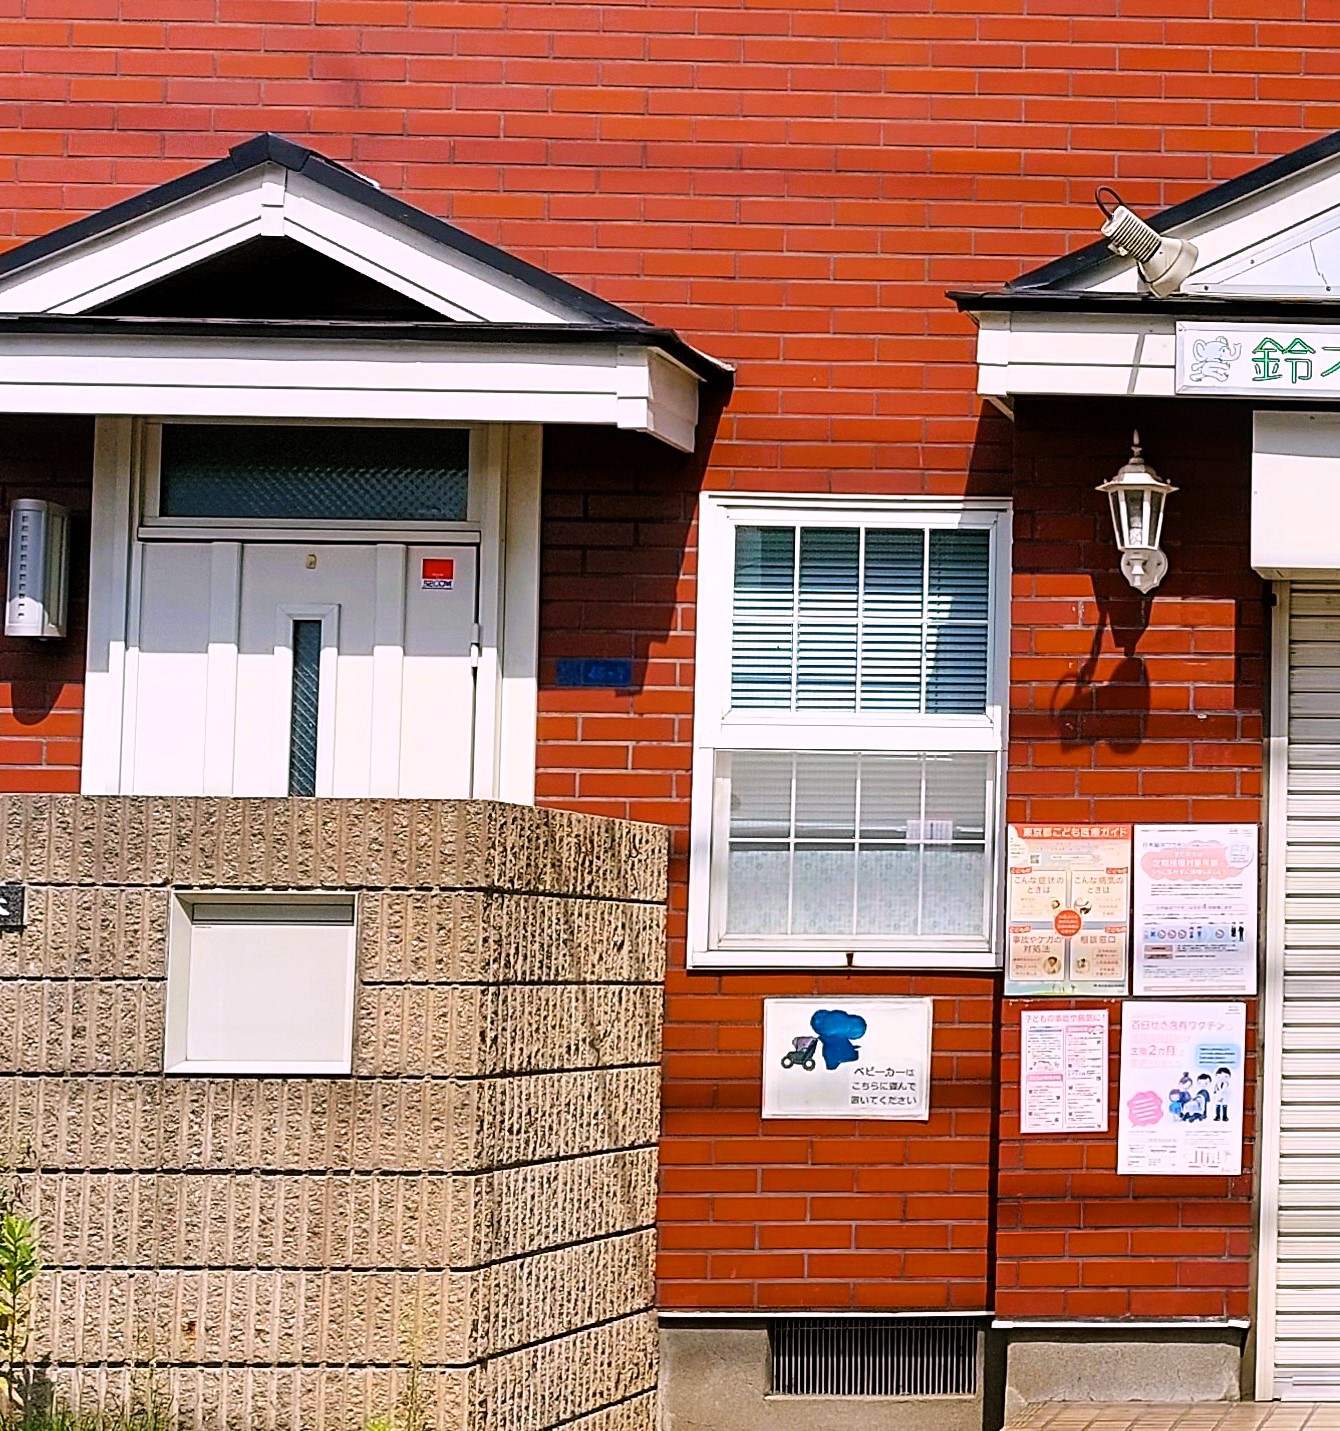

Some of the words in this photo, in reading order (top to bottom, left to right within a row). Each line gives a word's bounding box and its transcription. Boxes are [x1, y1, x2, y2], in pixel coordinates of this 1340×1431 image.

[1022, 827, 1128, 838] 東京都こども医療ガイド
[853, 1066, 915, 1077] ベビーカーは
[851, 1095, 917, 1106] 置いてください
